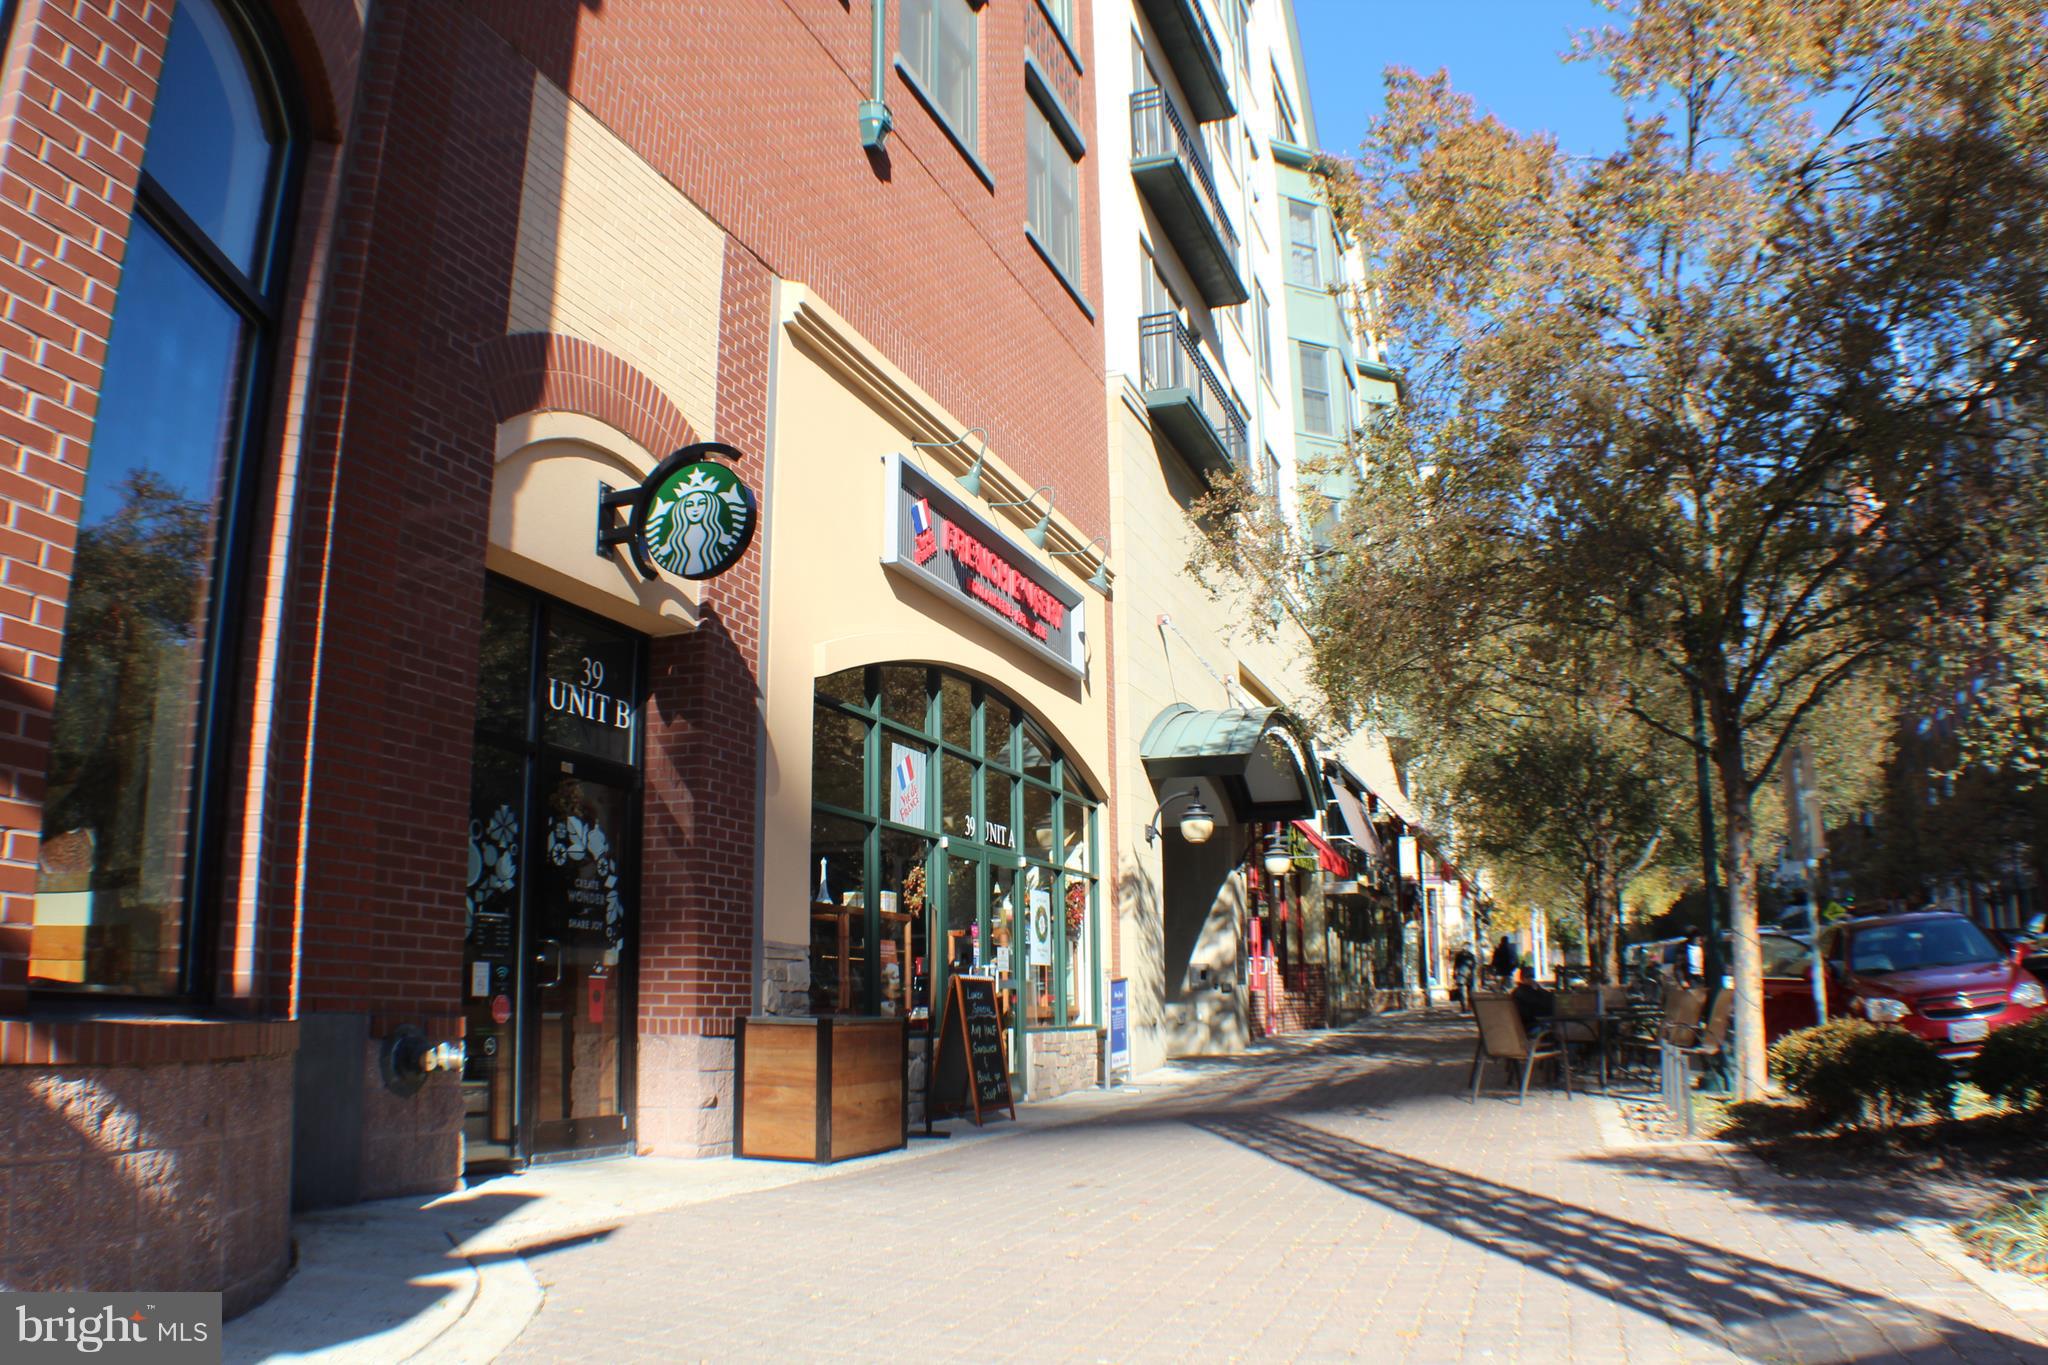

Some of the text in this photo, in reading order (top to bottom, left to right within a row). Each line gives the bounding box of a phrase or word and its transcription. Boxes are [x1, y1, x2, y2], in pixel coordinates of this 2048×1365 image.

[580, 657, 604, 689] 39
[549, 677, 631, 729] UNIT B
[964, 814, 976, 837] 39
[1008, 828, 1016, 849] A
